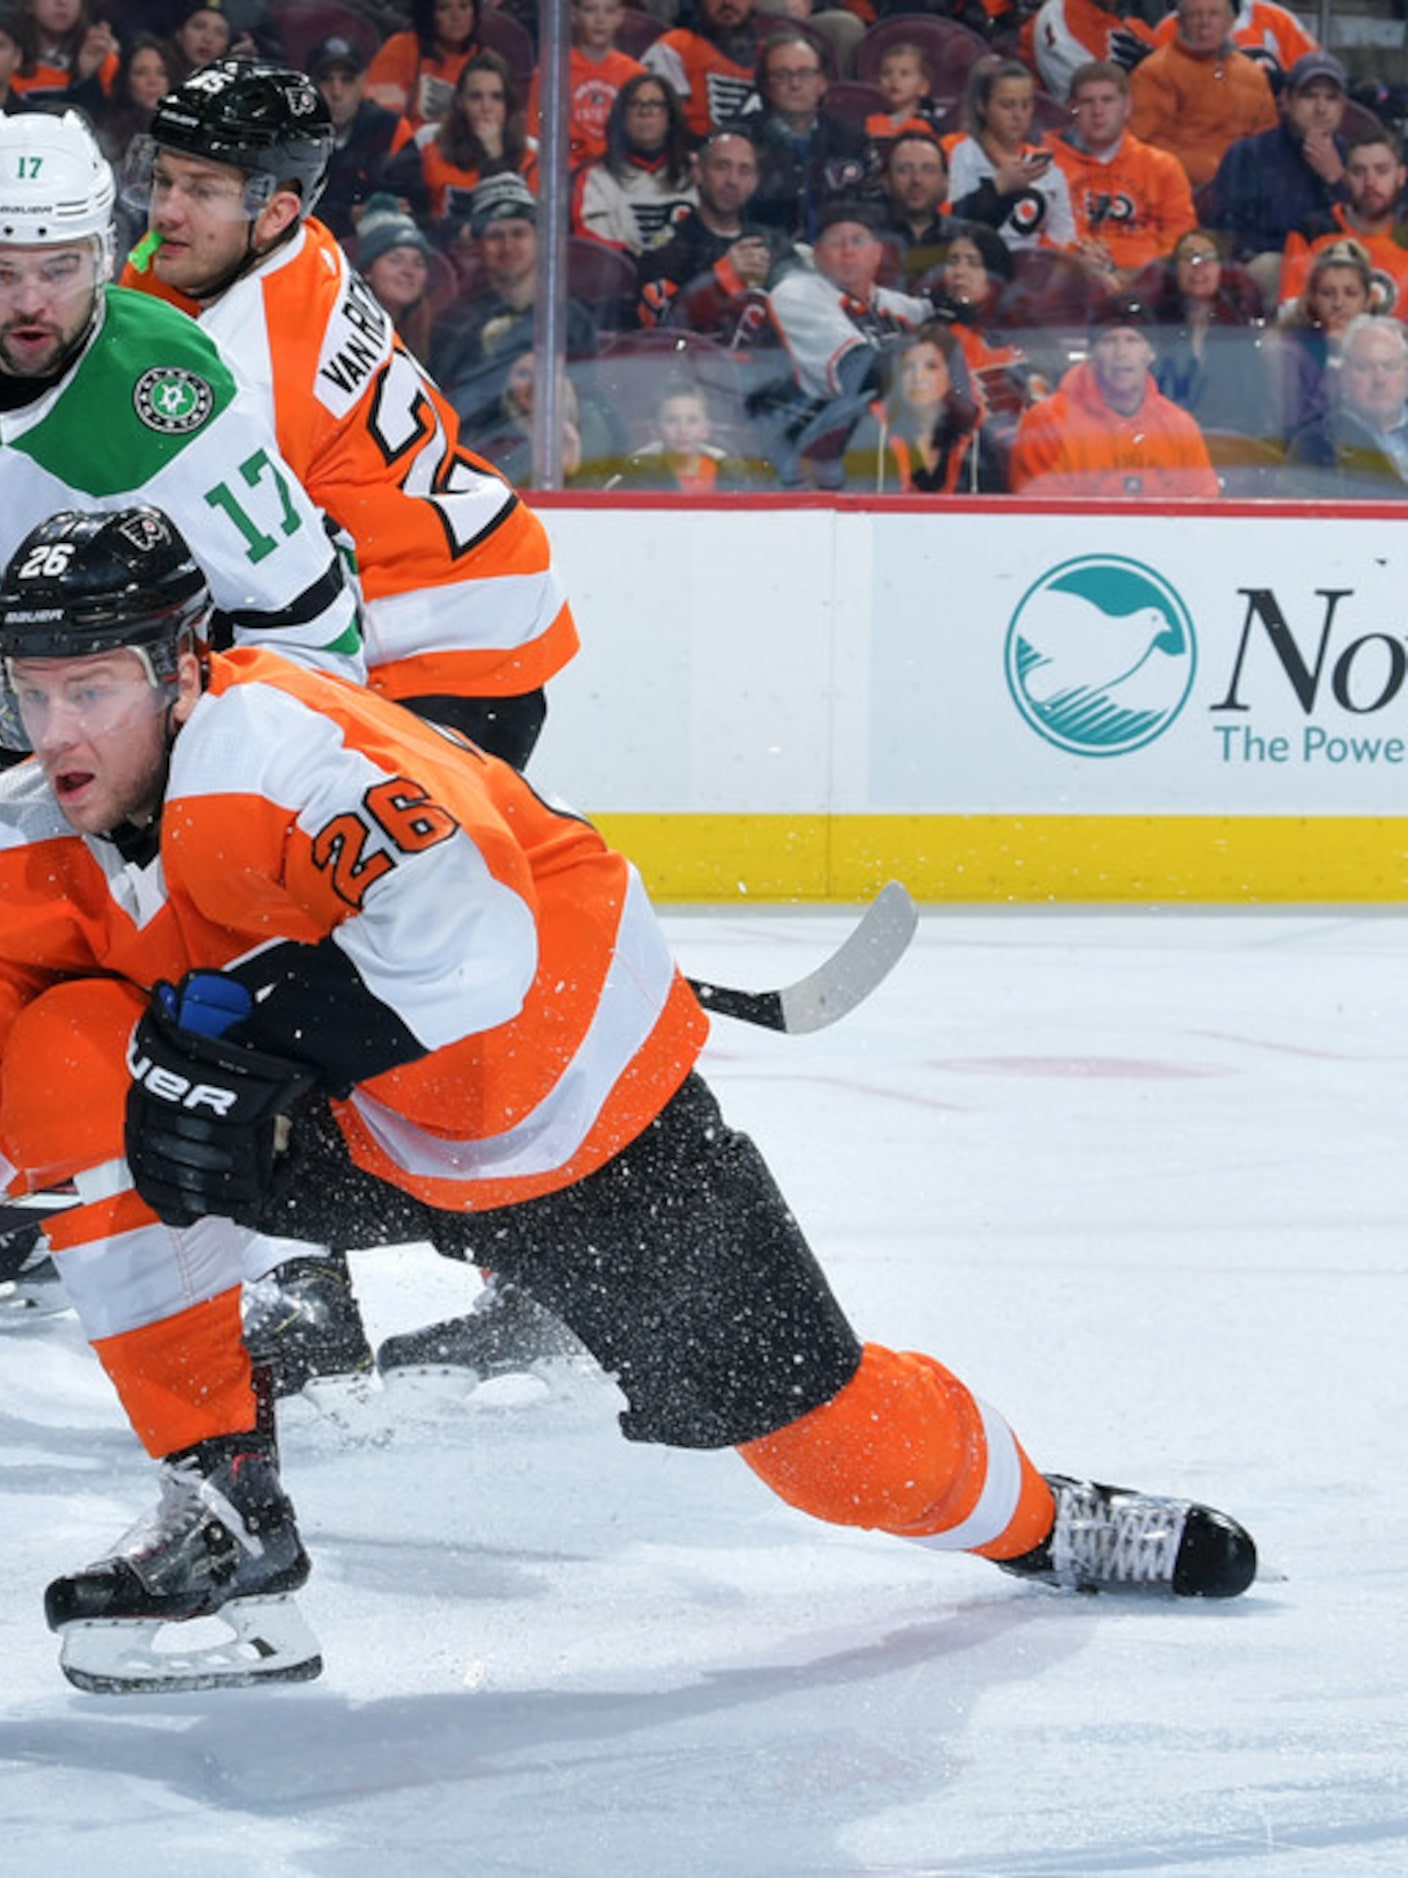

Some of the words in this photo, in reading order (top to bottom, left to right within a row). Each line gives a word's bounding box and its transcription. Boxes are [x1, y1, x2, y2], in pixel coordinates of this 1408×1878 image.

[17, 157, 43, 179] 17
[319, 334, 380, 394] VAN
[366, 345, 520, 562] 2
[203, 448, 303, 565] 17
[18, 543, 76, 580] 26
[1209, 587, 1408, 715] No
[1213, 725, 1289, 763] The
[1303, 725, 1405, 764] Powe
[311, 776, 461, 912] 26
[126, 1020, 238, 1116] UER
